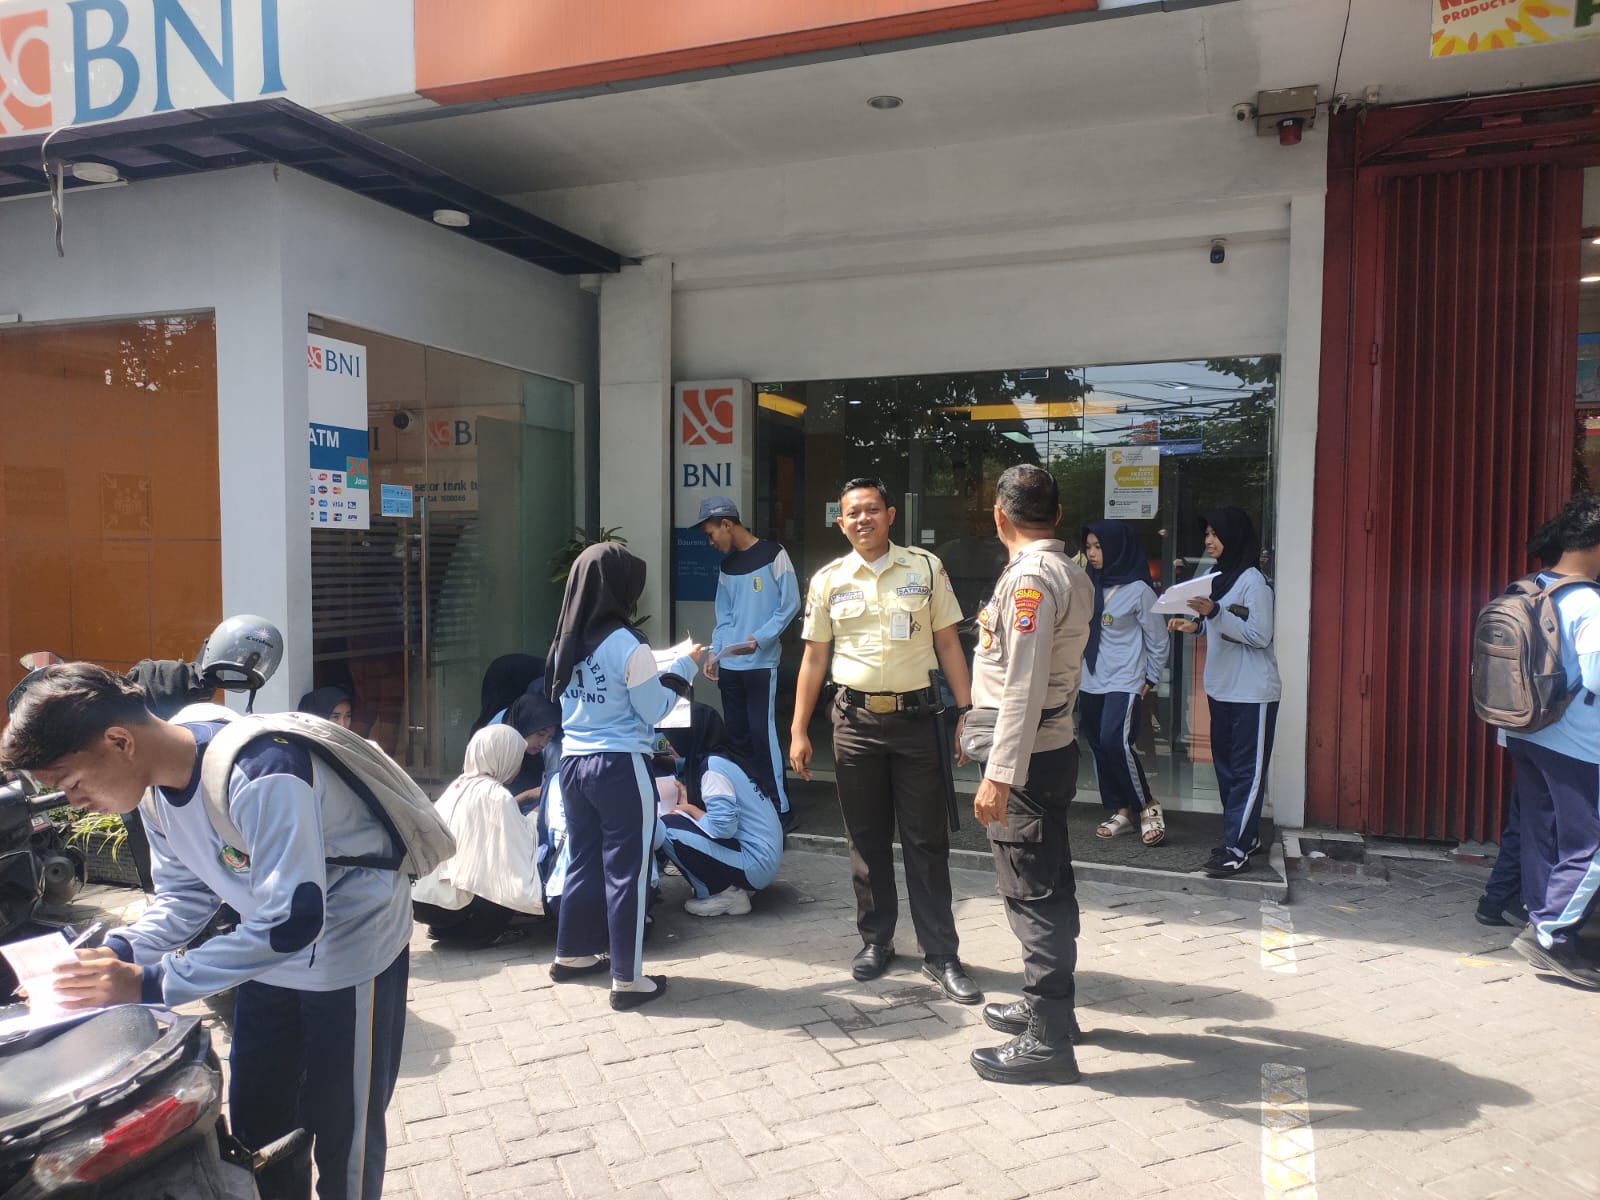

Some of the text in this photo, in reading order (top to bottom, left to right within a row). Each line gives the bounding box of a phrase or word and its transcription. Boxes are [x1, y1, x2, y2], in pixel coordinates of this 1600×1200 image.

[67, 0, 288, 125] BNI
[325, 349, 361, 378] BNI
[309, 427, 340, 449] ATM
[347, 457, 367, 477] 24
[683, 463, 732, 488] BNI
[575, 669, 585, 689] 1
